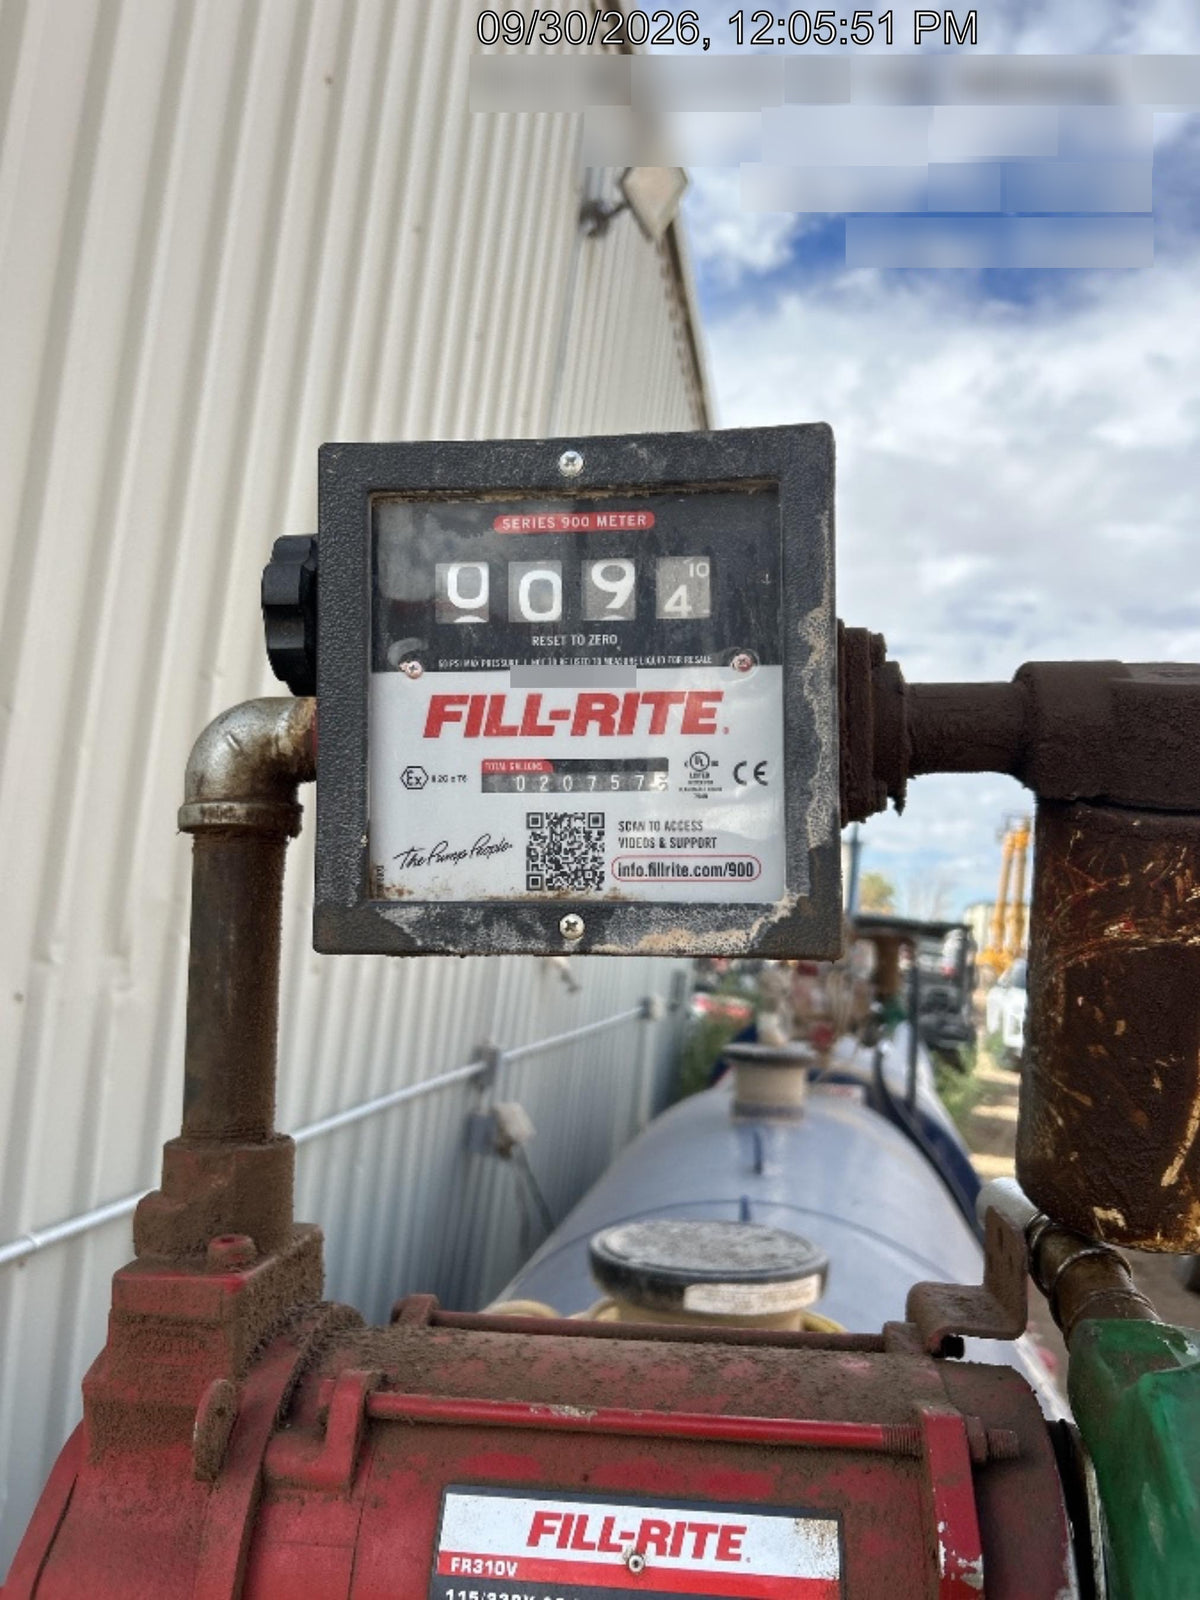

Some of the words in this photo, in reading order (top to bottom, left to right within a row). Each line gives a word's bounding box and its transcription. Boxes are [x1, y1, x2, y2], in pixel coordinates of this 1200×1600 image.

[502, 516, 556, 530] SERIES
[560, 515, 590, 529] 900
[597, 514, 647, 528] METER
[531, 635, 566, 647] RESET
[569, 634, 586, 646] TO
[587, 633, 618, 646] ZERO
[422, 690, 724, 739] FILL-RITE
[618, 820, 646, 832] SCAN
[649, 820, 661, 832] TO
[664, 819, 704, 832] ACCESS
[618, 836, 656, 849] VIDEOS
[658, 837, 667, 849] &
[669, 836, 718, 849] SUPPORT
[617, 861, 755, 878] info.fillrite.com/900
[526, 1509, 747, 1563] FILL-RITE
[450, 1556, 519, 1577] FR310V
